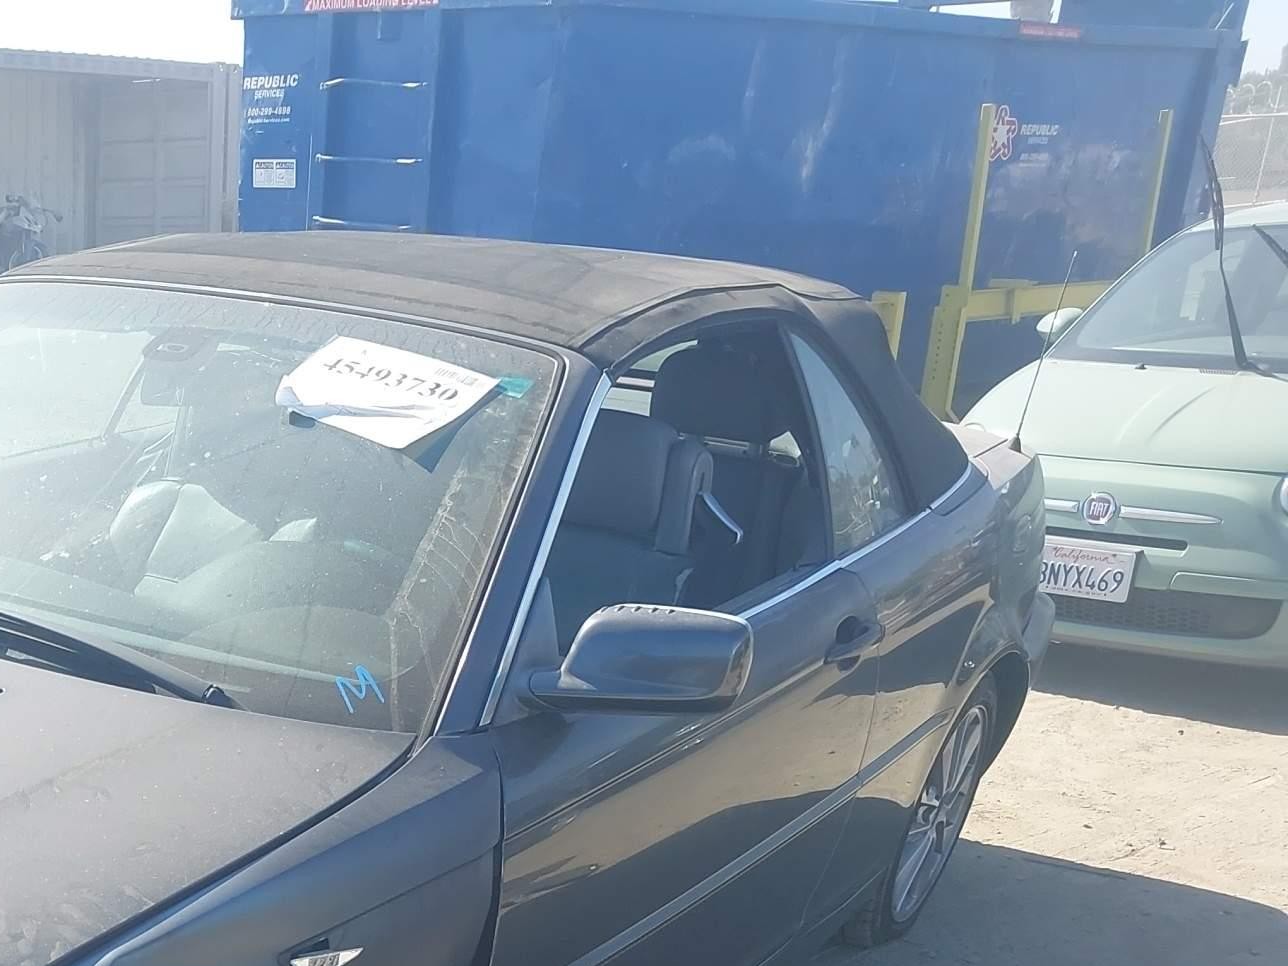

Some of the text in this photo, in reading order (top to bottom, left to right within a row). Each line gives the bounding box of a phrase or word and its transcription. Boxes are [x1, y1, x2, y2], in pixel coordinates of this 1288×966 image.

[243, 74, 299, 90] REPUBLIC
[254, 89, 285, 99] SERVICES
[1020, 124, 1059, 136] REPUBLIC
[323, 358, 459, 401] 45493730
[1089, 501, 1110, 517] FIAT
[1053, 546, 1110, 563] California
[335, 664, 385, 714] M
